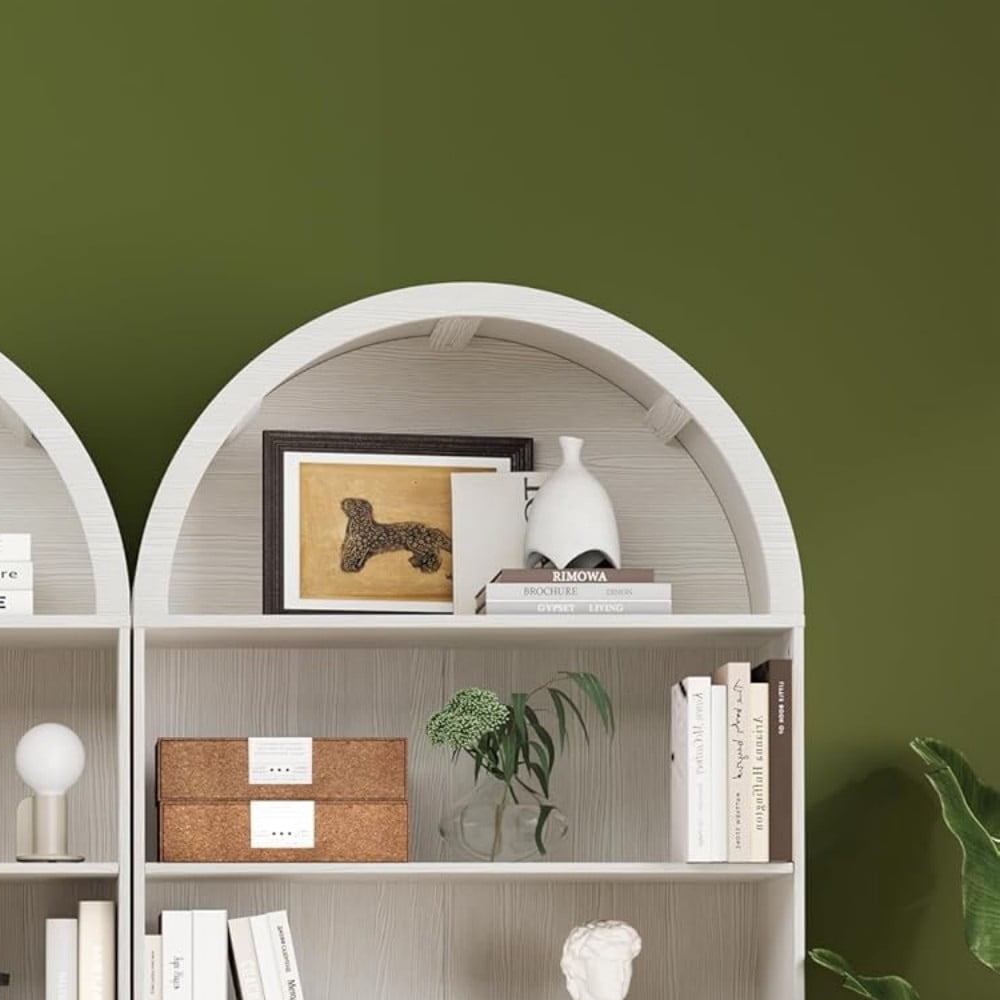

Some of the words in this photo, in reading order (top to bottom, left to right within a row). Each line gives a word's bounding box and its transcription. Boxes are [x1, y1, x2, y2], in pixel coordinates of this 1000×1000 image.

[552, 572, 608, 582] RIMOWA
[523, 586, 578, 596] BROCHURE
[589, 603, 625, 613] LIVING
